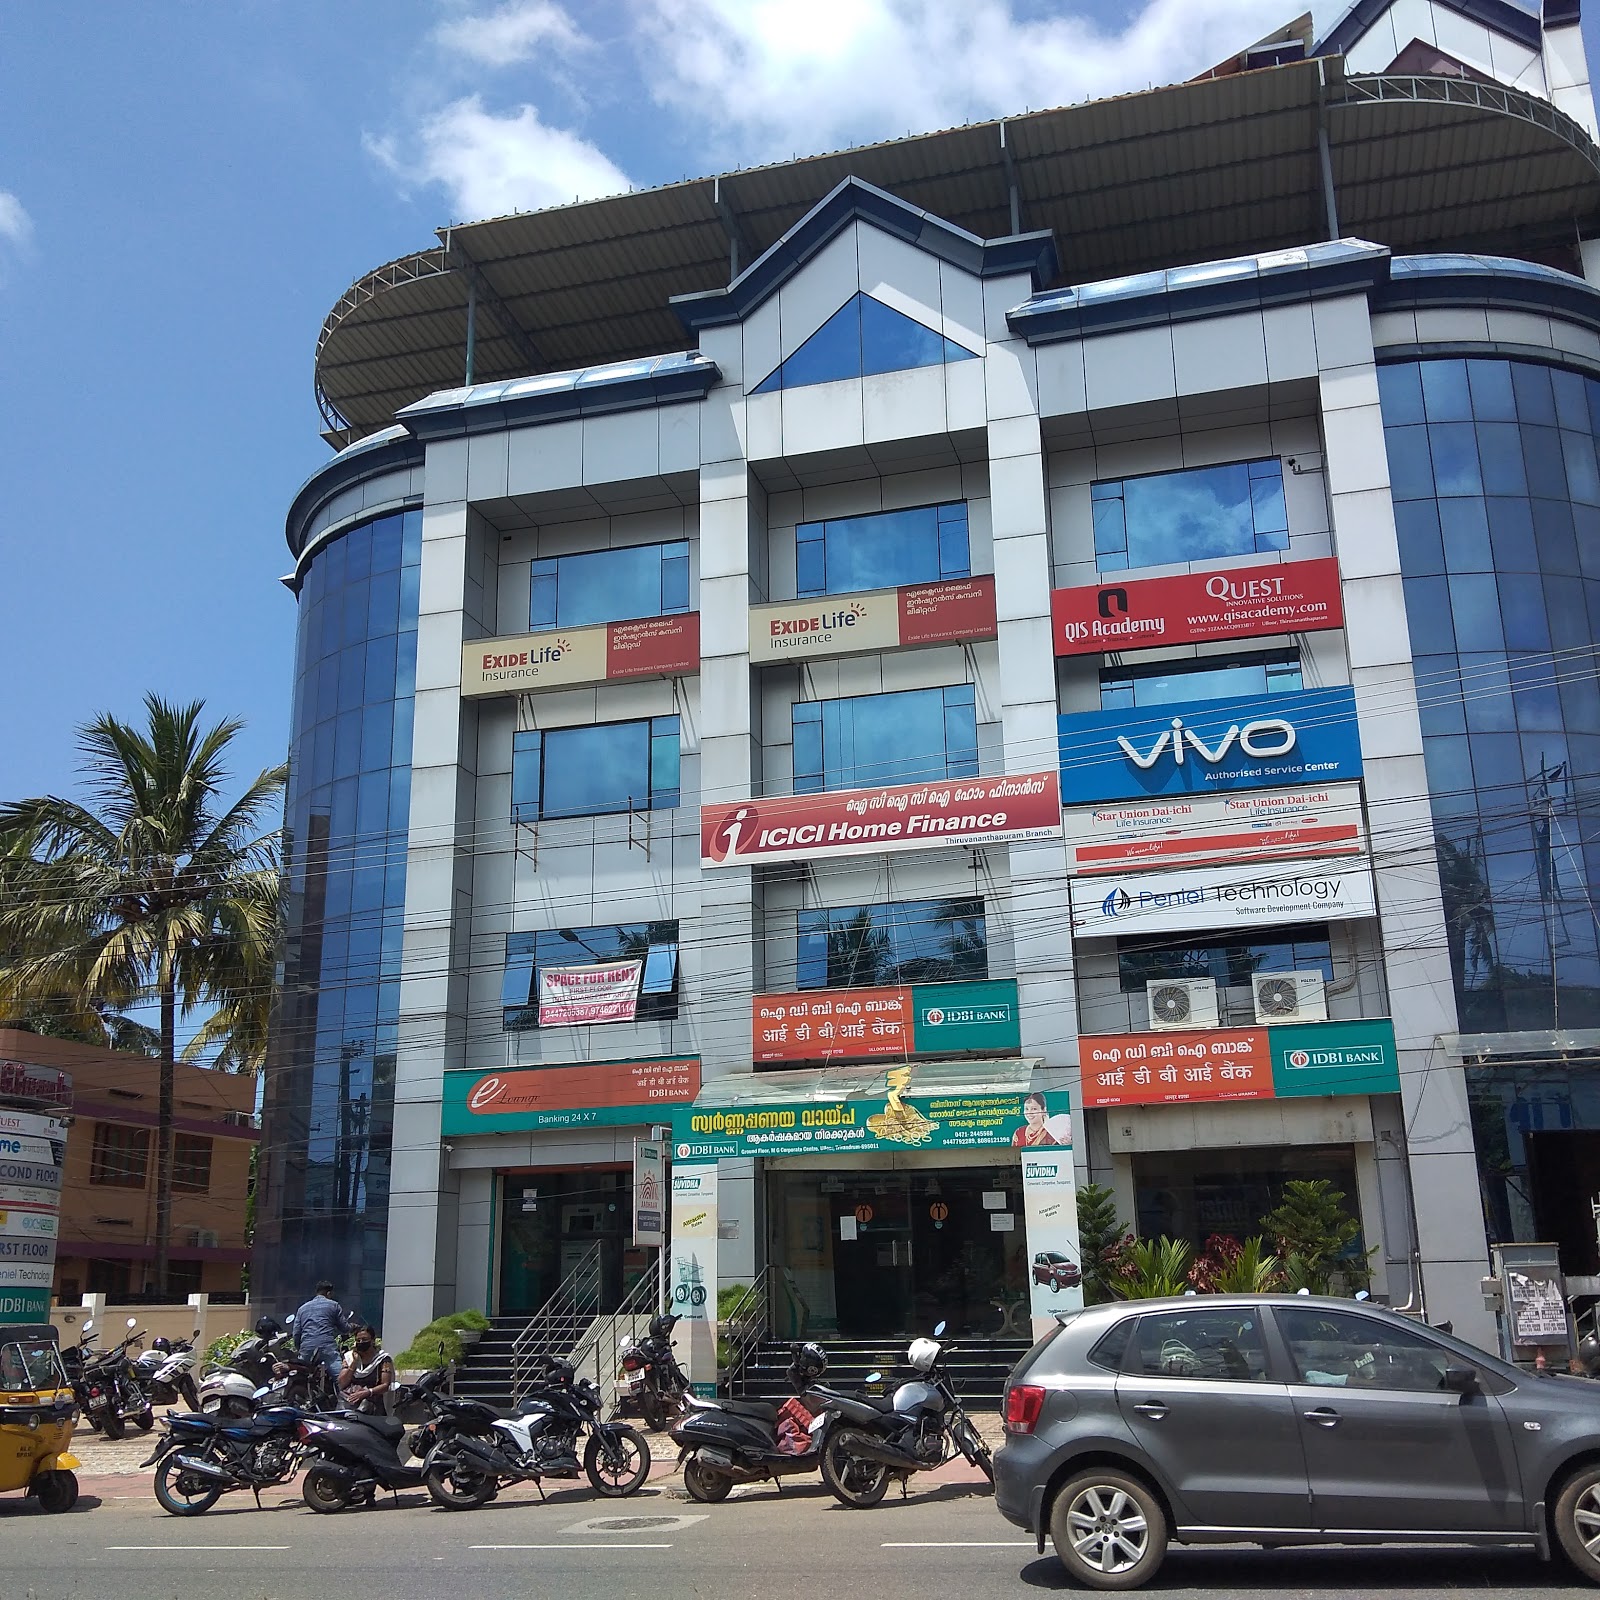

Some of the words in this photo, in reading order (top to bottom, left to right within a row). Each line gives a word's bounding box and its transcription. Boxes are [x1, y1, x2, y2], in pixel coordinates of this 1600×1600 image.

[1206, 576, 1284, 601] QUEST
[1226, 598, 1265, 607] INNOVATIVE
[1267, 594, 1303, 603] SOLUTIONS
[1188, 601, 1326, 624] www.qisacademy.com
[770, 617, 819, 635] EXIDE
[822, 611, 855, 629] Life
[1065, 622, 1088, 642] QIS
[1093, 617, 1164, 636] Academy
[771, 633, 831, 649] Insurance
[483, 652, 528, 669] EXIDE
[531, 648, 561, 664] Life
[482, 667, 538, 681] Insurance
[1204, 768, 1262, 780] Authorised
[1264, 764, 1302, 776] Service
[1305, 760, 1339, 771] Center
[870, 792, 887, 809] സി
[911, 788, 928, 805] സി
[955, 788, 984, 801] ഹോം
[989, 776, 1048, 797] ഫിനാൻസ്
[1230, 801, 1250, 810] Star
[1253, 797, 1284, 807] Union
[1287, 793, 1328, 804] Dai-ichi
[1097, 813, 1116, 821] Star
[1119, 809, 1150, 819] Union
[1152, 805, 1192, 816] Dai-ichi
[1250, 808, 1265, 816] Life
[1267, 805, 1308, 814] Insurance
[759, 824, 823, 848] ICICI
[828, 821, 901, 841] Home
[907, 812, 1007, 833] Finance
[1133, 817, 1171, 826] Insurance
[945, 833, 1023, 844] Thiruvananthapuram
[1026, 829, 1053, 838] Branch
[1140, 886, 1204, 908] Peniel
[1215, 880, 1341, 902] Technology
[1236, 906, 1265, 916] Software
[1267, 903, 1311, 914] Development
[1313, 901, 1343, 911] Company
[547, 974, 581, 987] SPACE
[584, 973, 604, 984] FOR
[608, 968, 636, 982] RENT
[761, 1008, 785, 1020] ഐ
[790, 1003, 808, 1016] ഡി
[812, 1001, 831, 1015] ബി
[836, 1002, 861, 1015] ഐ
[948, 1012, 974, 1021] IDBI
[977, 1011, 1005, 1020] BANK
[763, 1024, 788, 1042] आई
[795, 1023, 811, 1040] डी
[818, 1022, 834, 1038] बी
[840, 1019, 866, 1038] आई
[872, 1017, 901, 1035] बैंक
[1093, 1050, 1121, 1062] ഐ
[1126, 1044, 1146, 1059] ഡി
[1151, 1043, 1173, 1058] ബി
[1178, 1045, 1206, 1058] ഐ
[1212, 1038, 1254, 1054] ബാങ്ക്
[1313, 1052, 1343, 1064] IDBI
[1347, 1051, 1379, 1063] BANK
[1097, 1067, 1125, 1086] आई
[1133, 1066, 1151, 1085] डी
[1159, 1065, 1177, 1083] बी
[1184, 1062, 1213, 1082] आई
[1219, 1061, 1253, 1080] बैंक
[649, 1089, 667, 1097] IDBI
[539, 1115, 569, 1123] Banking
[802, 1104, 855, 1126] വായ്പ
[747, 1131, 812, 1144] ആകർഷകമായ
[815, 1127, 865, 1141] നിരക്കുകൾ
[692, 1146, 712, 1154] IDBI
[714, 1146, 735, 1154] BANK
[1027, 1167, 1055, 1177] SUVIDHA
[674, 1180, 698, 1189] SUVIDHA
[22, 1244, 48, 1257] FLOOR
